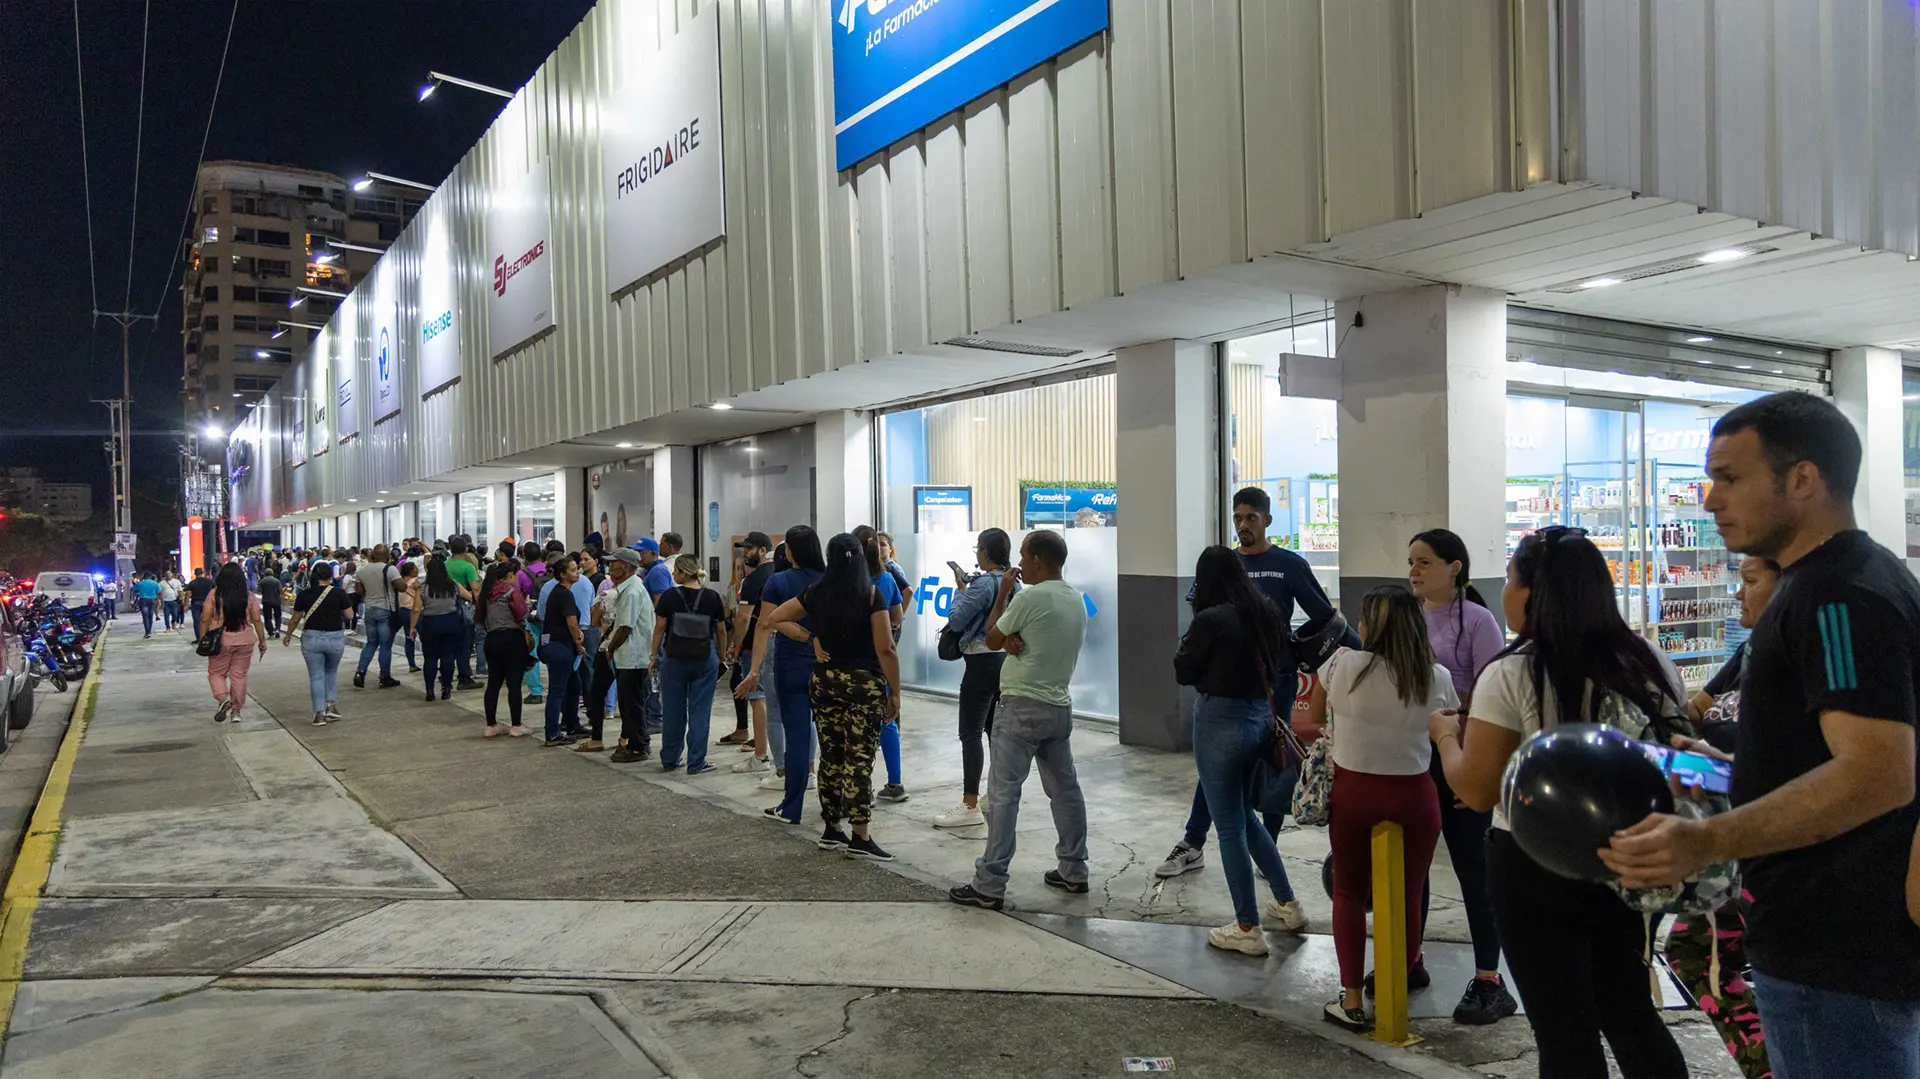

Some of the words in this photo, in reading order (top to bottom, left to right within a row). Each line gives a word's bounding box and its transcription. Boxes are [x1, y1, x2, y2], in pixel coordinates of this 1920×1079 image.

[617, 117, 700, 200] FRIGIDAIRE
[507, 239, 544, 280] ELECTRONICS
[422, 309, 452, 344] Hisense
[1261, 570, 1285, 579] DIFFERENT
